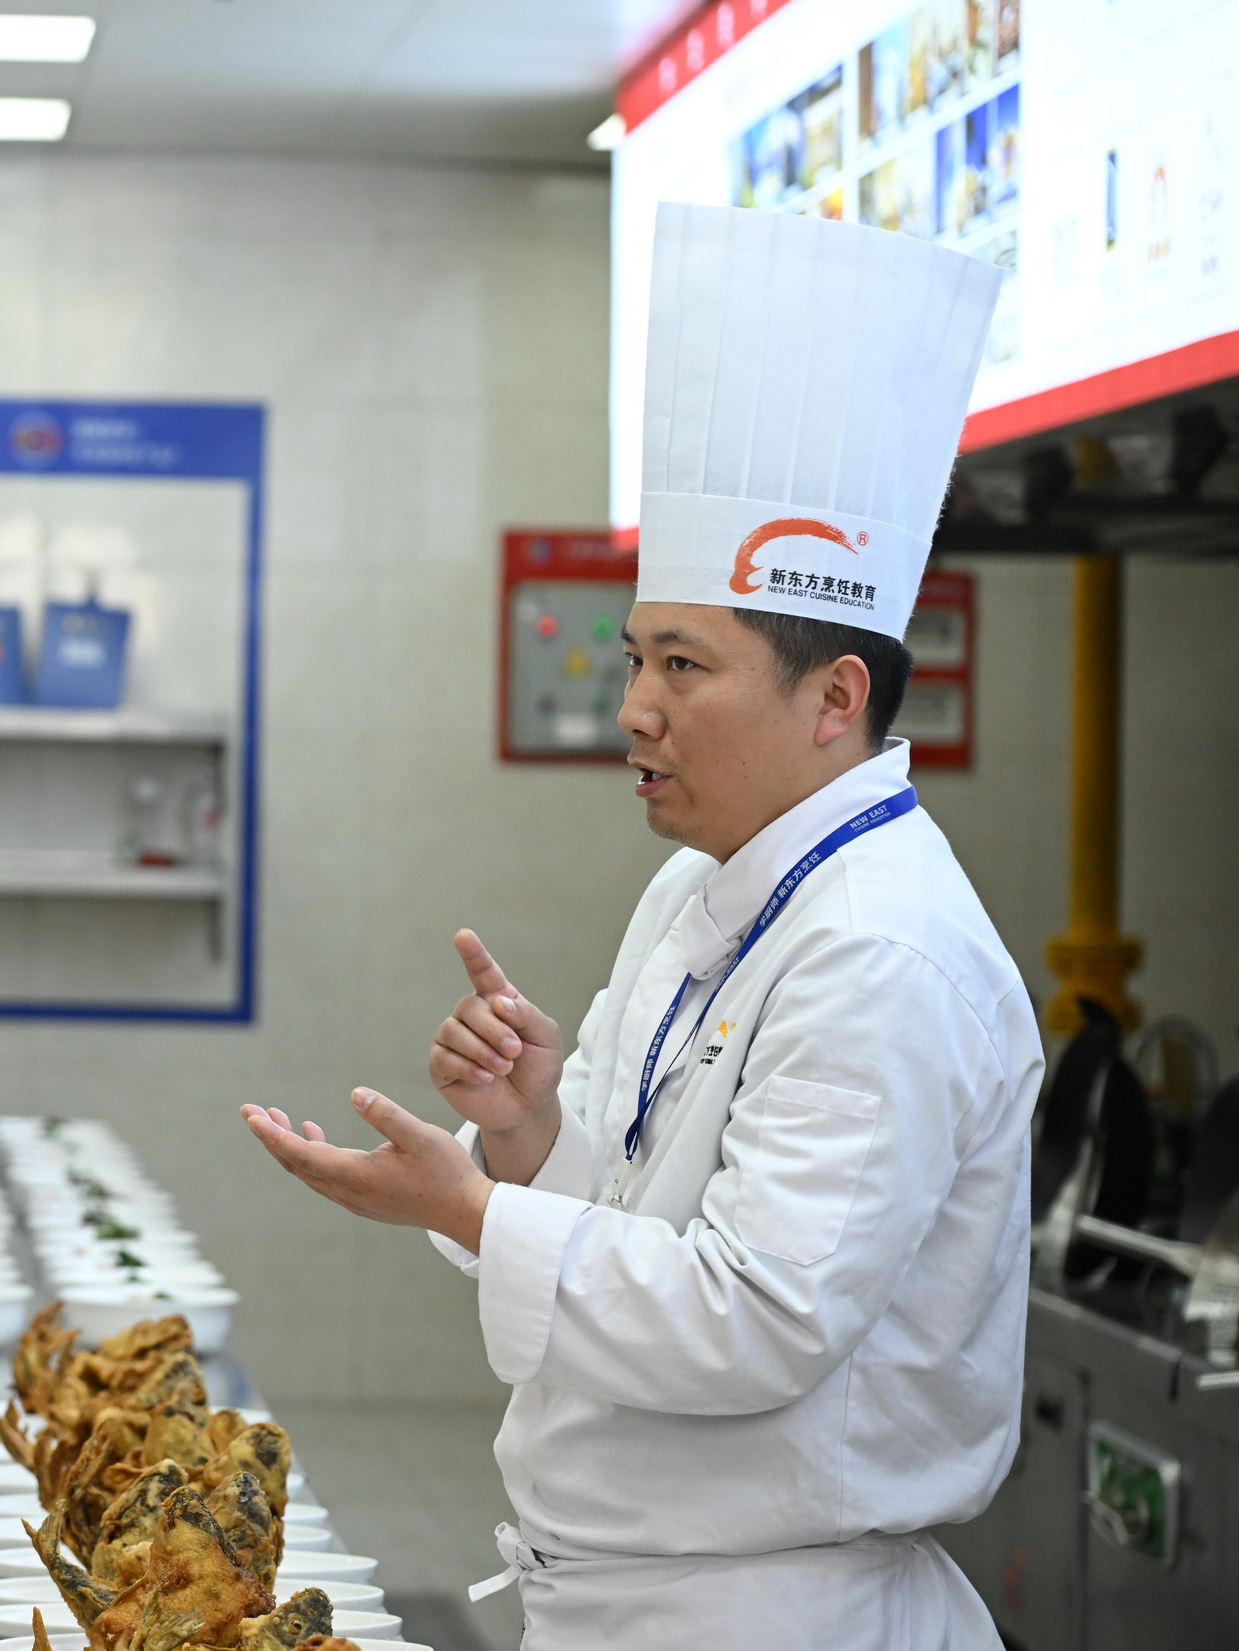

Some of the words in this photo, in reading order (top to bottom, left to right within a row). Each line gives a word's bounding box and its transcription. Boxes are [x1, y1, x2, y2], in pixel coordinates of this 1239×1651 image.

[767, 585, 786, 595] NEW
[787, 588, 808, 598] EAST
[809, 591, 839, 603] CUISINE
[839, 597, 875, 611] EDUCATION
[769, 568, 877, 602] 新东方烹饪教育
[849, 815, 868, 829] NEW
[868, 804, 888, 818] EAST
[777, 851, 822, 899] 新东方烹饪
